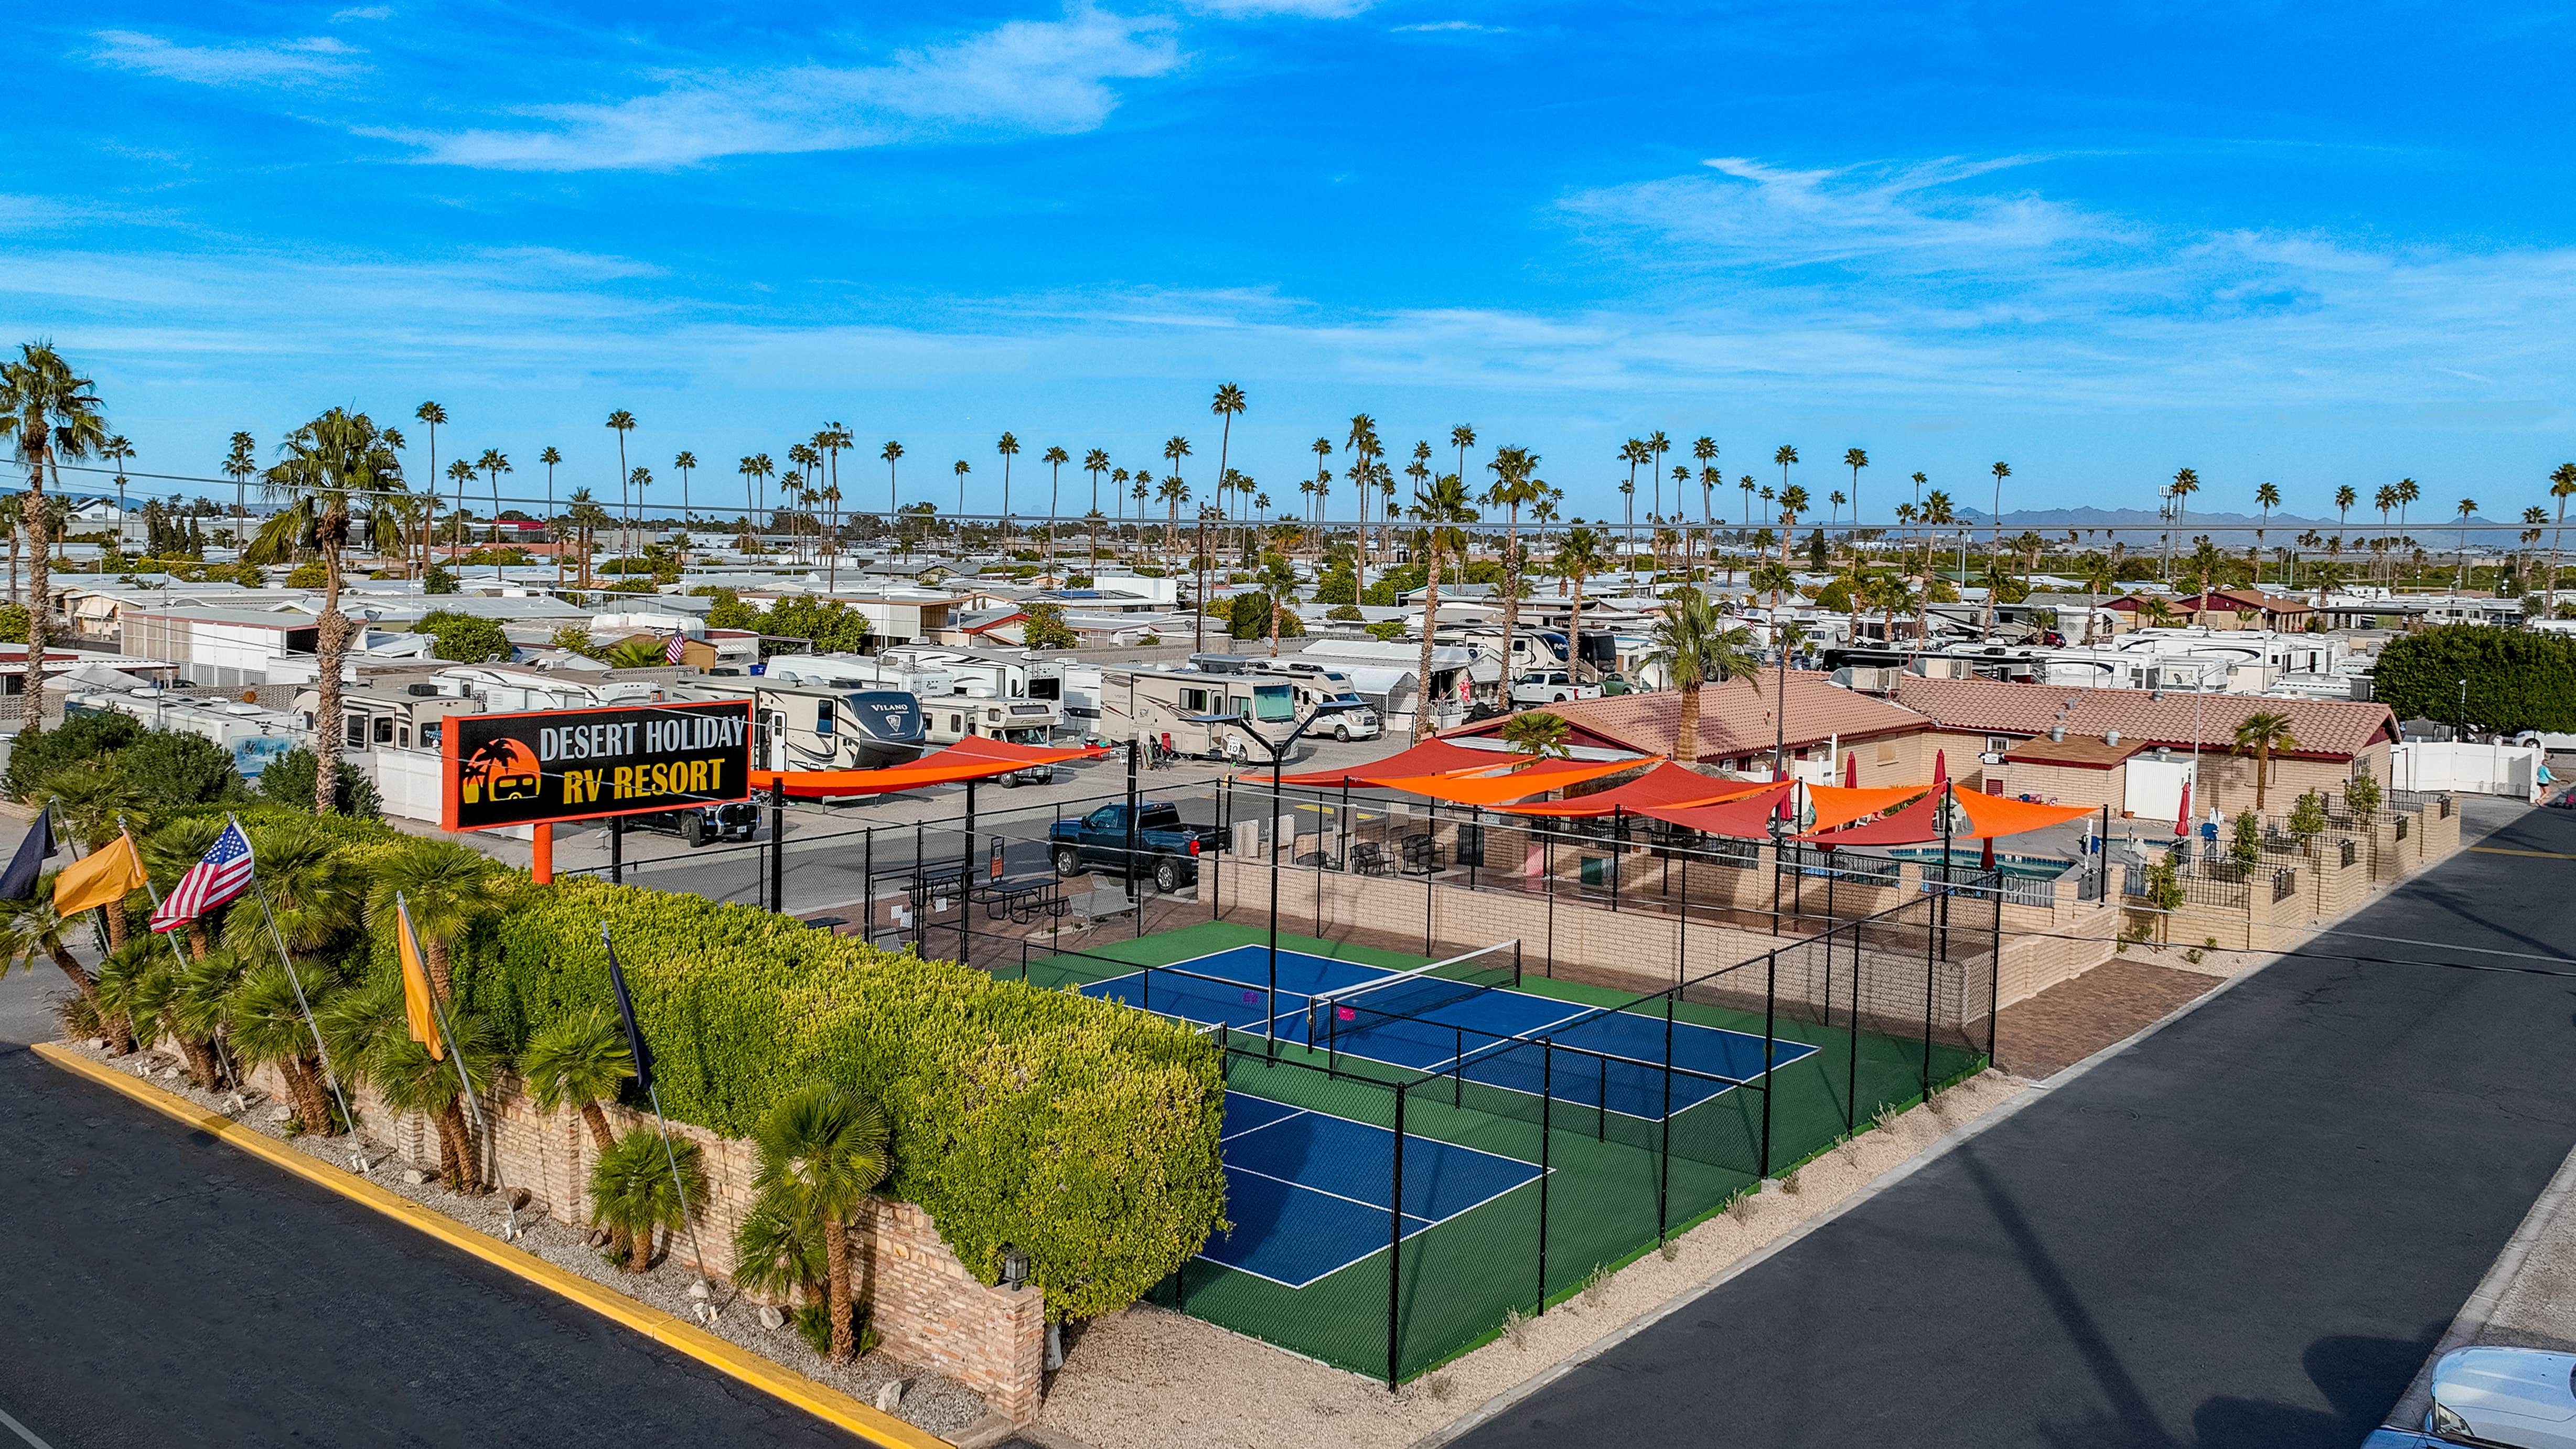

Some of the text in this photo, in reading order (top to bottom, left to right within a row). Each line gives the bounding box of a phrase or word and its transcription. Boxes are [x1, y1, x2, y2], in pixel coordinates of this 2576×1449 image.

[540, 715, 746, 761] DESERT HOLIDAY
[563, 758, 725, 804] RV RESORT
